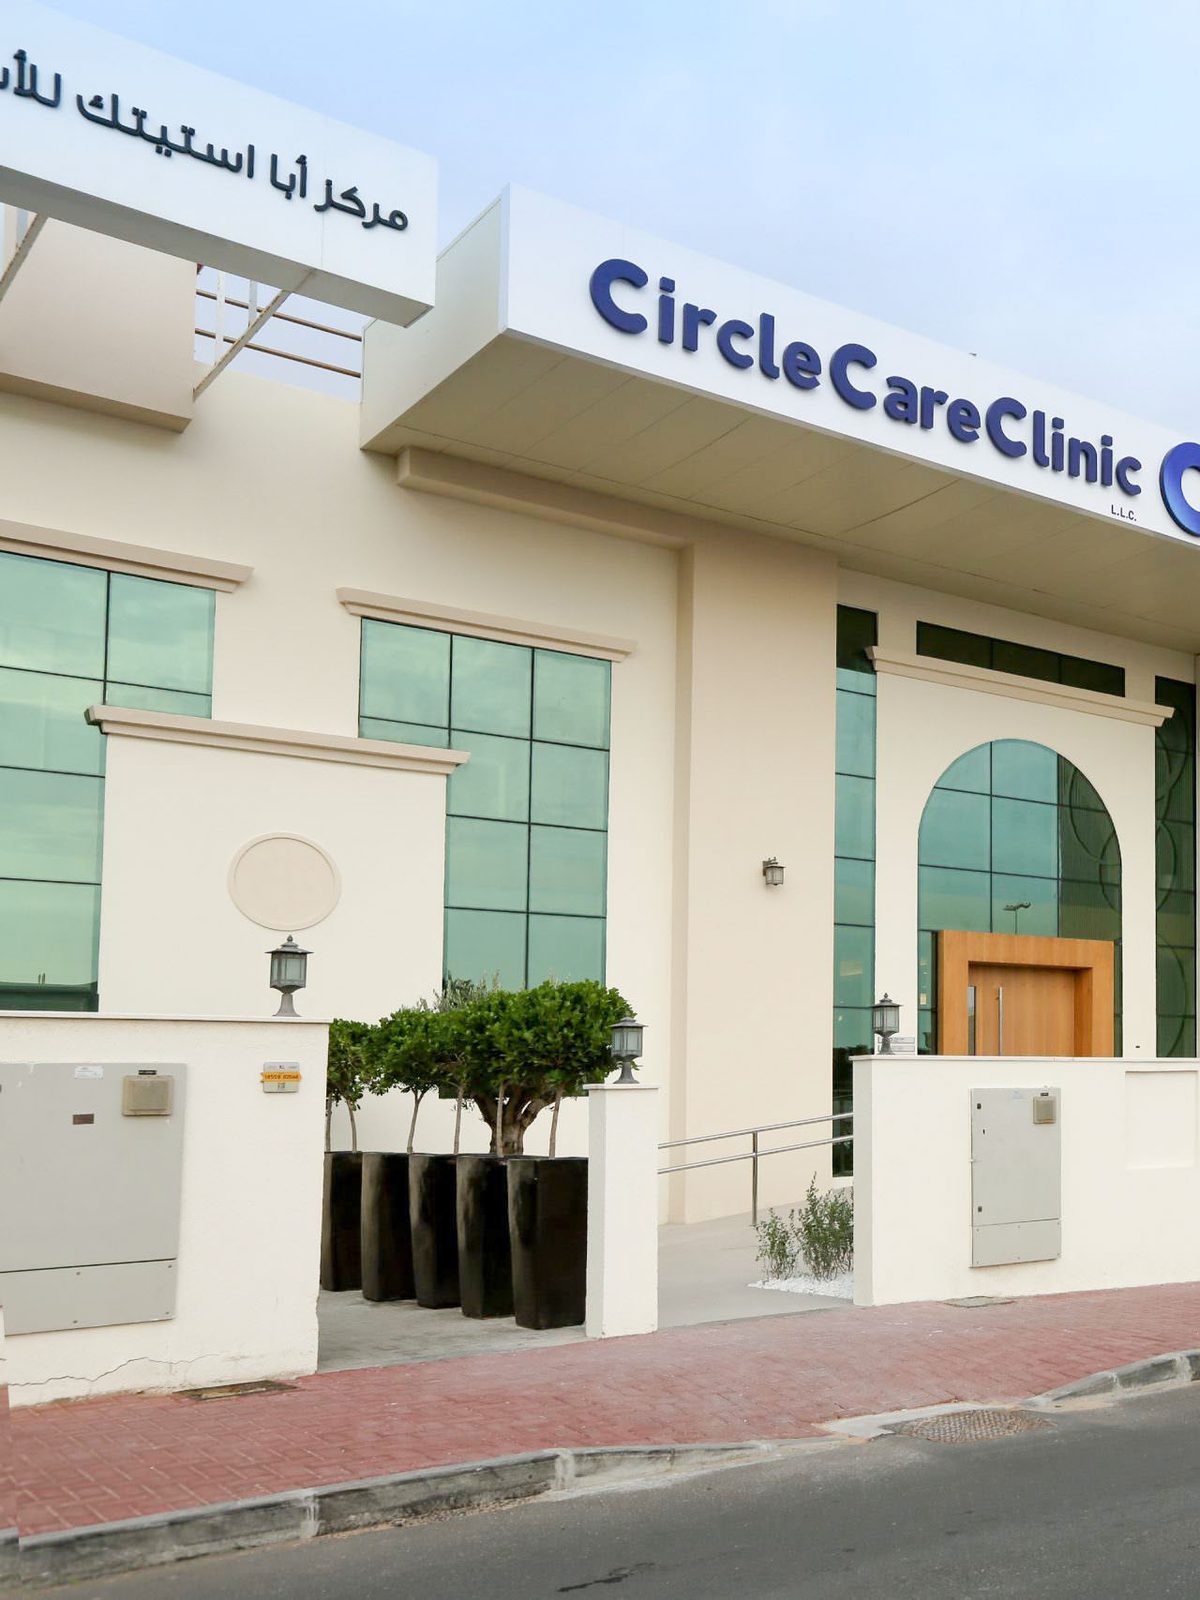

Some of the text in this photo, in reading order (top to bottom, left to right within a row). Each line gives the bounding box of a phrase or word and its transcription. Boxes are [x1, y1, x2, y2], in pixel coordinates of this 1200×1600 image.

[76, 93, 255, 179] استيتك
[270, 153, 308, 200] أبا
[314, 179, 409, 231] مركز
[1111, 504, 1137, 522] L.L.C.
